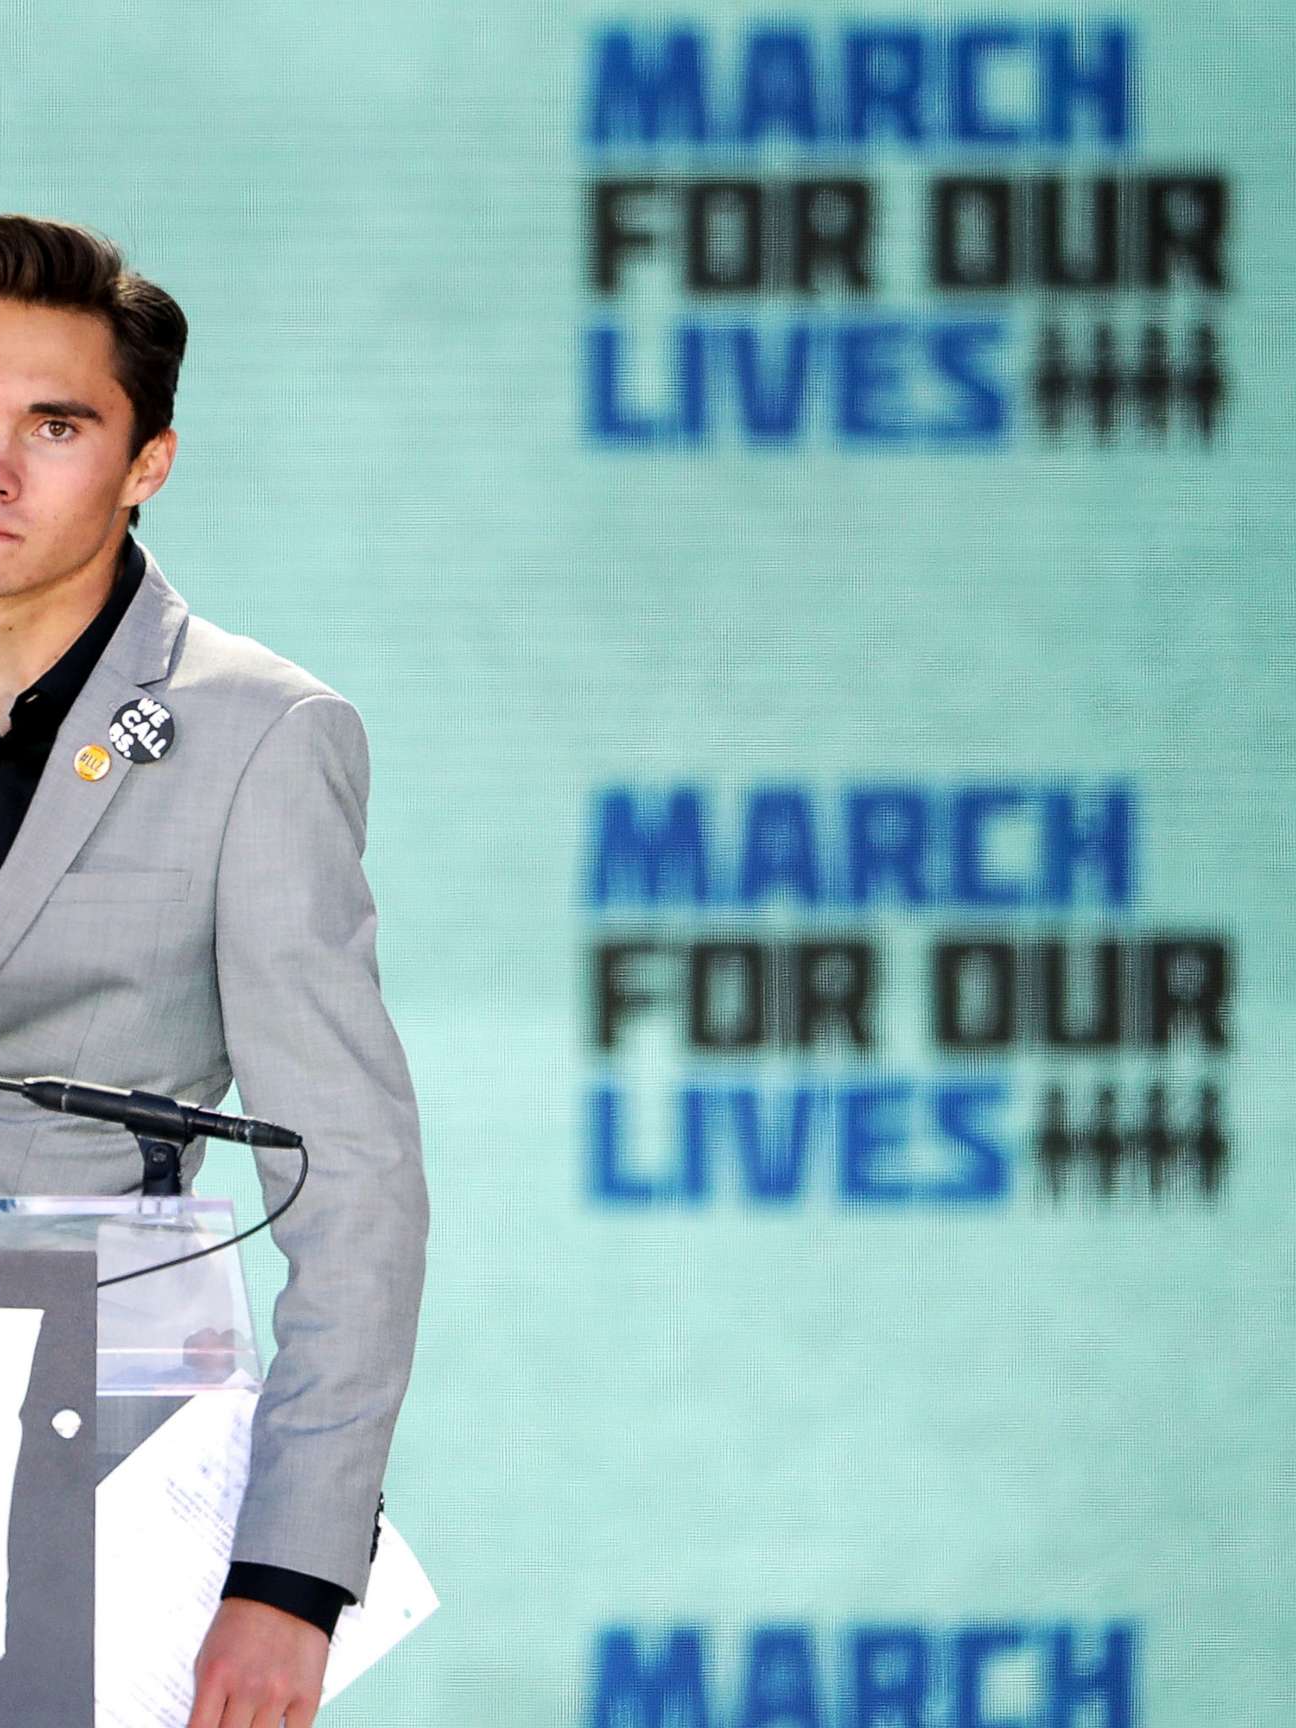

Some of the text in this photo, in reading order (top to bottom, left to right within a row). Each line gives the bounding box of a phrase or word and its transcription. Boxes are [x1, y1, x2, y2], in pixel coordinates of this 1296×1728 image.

[591, 30, 1131, 145] MARCH
[593, 177, 1228, 293] FOR OUR
[591, 322, 1009, 439] LIVES
[122, 709, 167, 758] CALL
[138, 698, 170, 728] WE
[592, 784, 1132, 904] MARCH
[594, 938, 1231, 1052] FOR OUR
[592, 1086, 1009, 1204] LIVES
[595, 1622, 1134, 1728] MARCH
